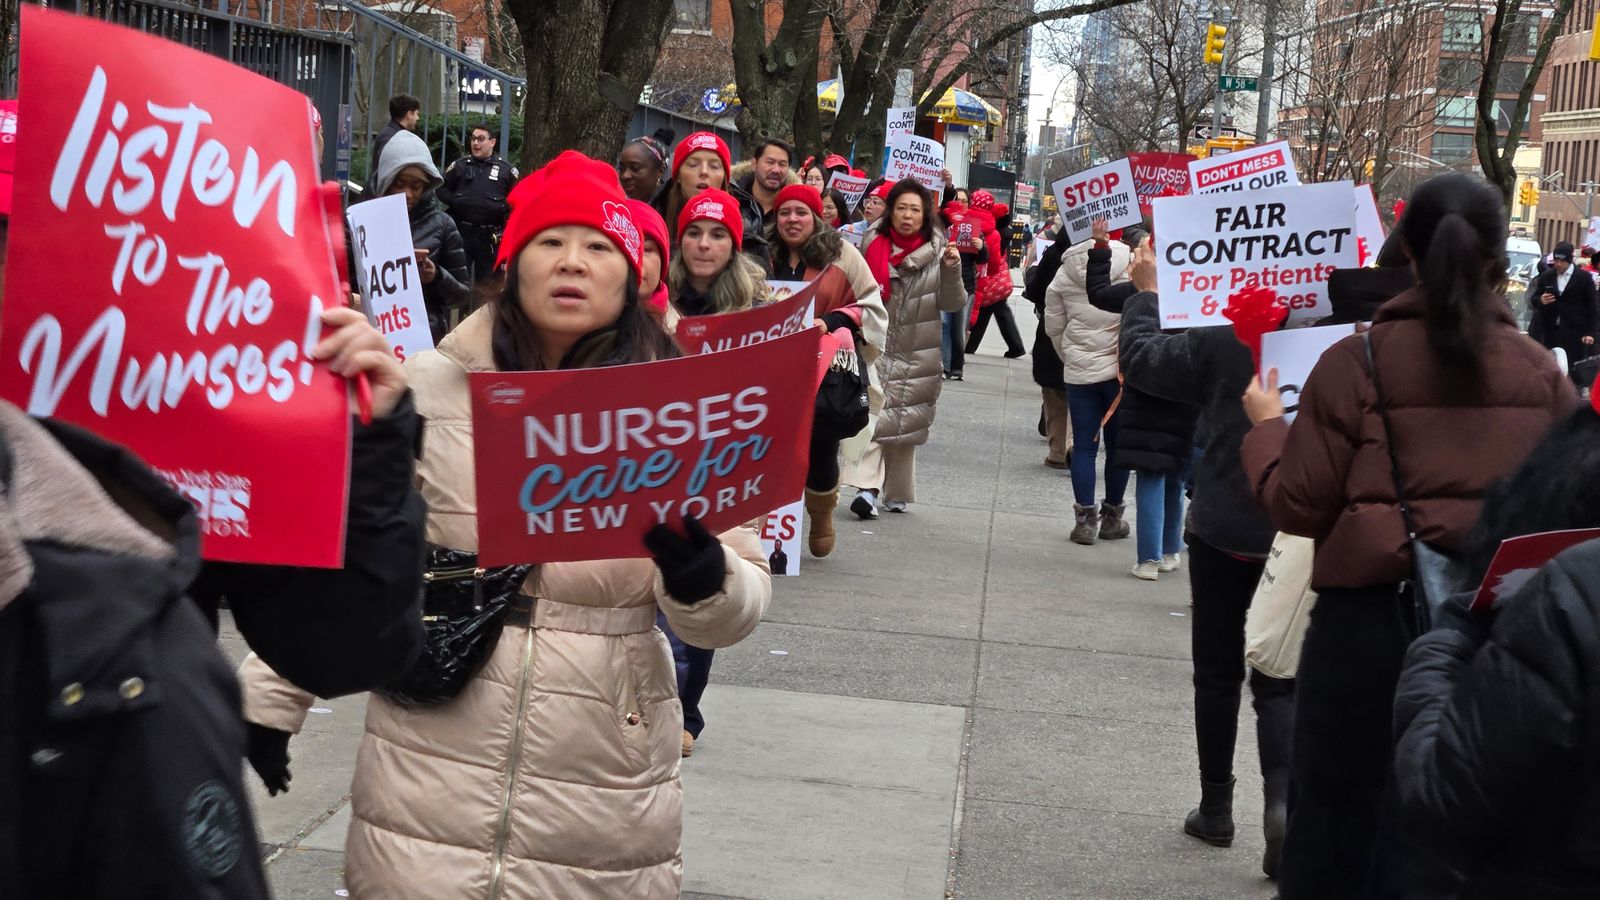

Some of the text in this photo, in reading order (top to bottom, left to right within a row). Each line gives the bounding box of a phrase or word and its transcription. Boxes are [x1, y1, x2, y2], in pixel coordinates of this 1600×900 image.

[1225, 77, 1233, 89] W
[1235, 78, 1246, 89] 58
[892, 148, 944, 168] CONTRACT
[909, 140, 932, 154] FAIR
[894, 160, 941, 178] For Patients
[898, 170, 905, 180] &
[1134, 164, 1188, 185] NURSES
[1202, 153, 1279, 184] DON'T MESS
[1248, 170, 1289, 190] OUR
[1063, 171, 1120, 208] STOP
[1065, 191, 1130, 222] HIDING THE TRUTH
[1071, 216, 1092, 233] ABOUT
[1112, 204, 1129, 218] $$$
[1214, 202, 1287, 233] FAIR
[1165, 227, 1352, 267] CONTRACT
[1179, 262, 1338, 293] For Patients
[1200, 294, 1220, 317] &
[19, 294, 324, 419] Nurses!
[524, 386, 769, 458] NURSES
[686, 433, 774, 497] for
[527, 473, 766, 536] NEW YORK
[760, 513, 798, 541] ES
